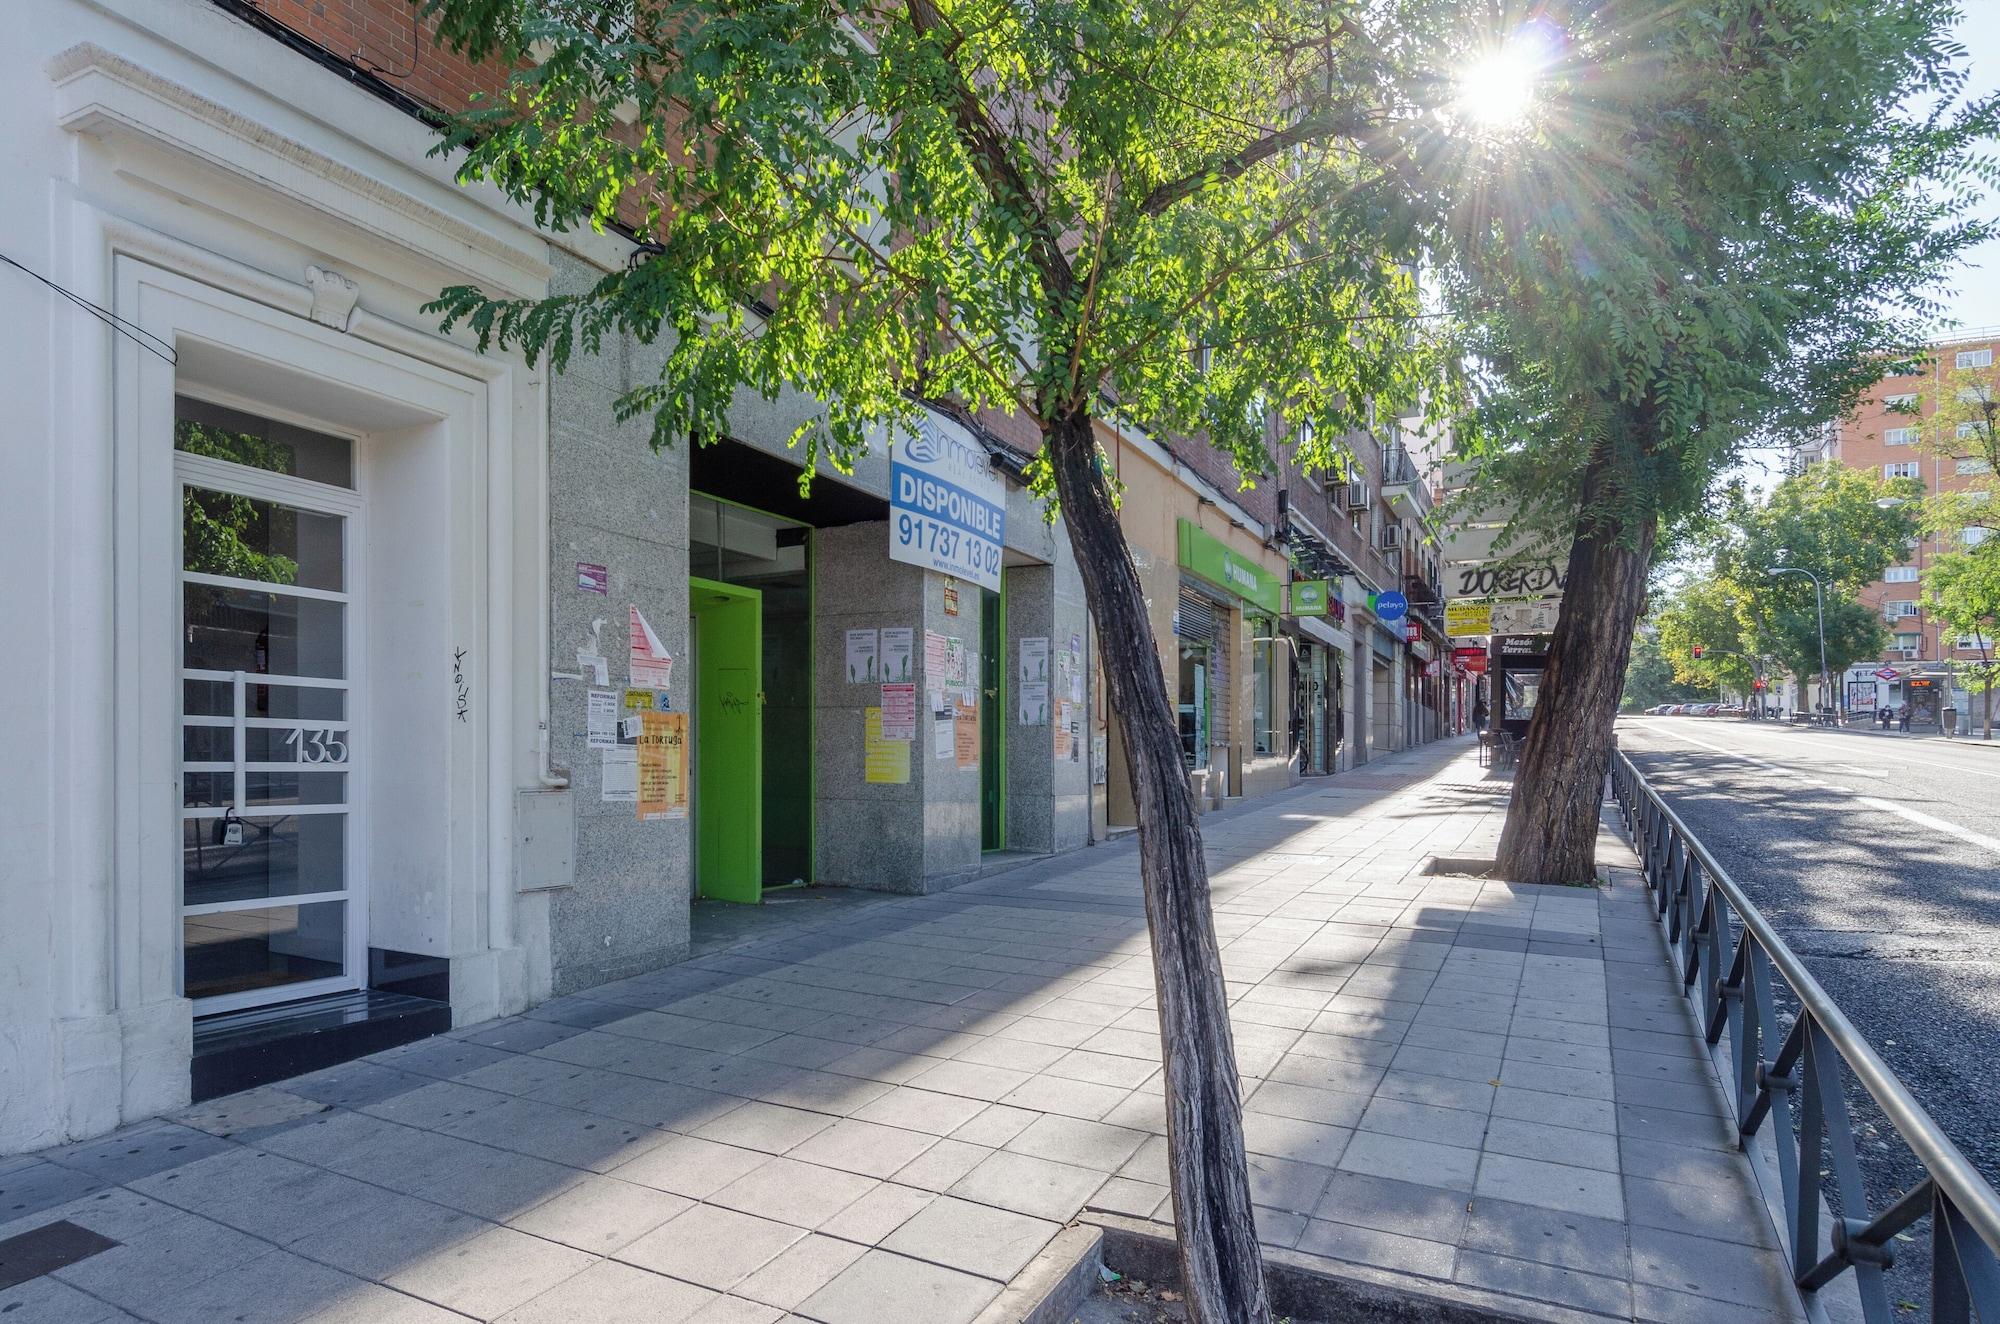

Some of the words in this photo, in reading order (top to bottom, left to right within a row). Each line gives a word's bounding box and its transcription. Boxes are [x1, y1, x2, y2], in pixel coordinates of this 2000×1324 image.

[899, 472, 1001, 540] DISPONIBLE
[898, 513, 923, 549] 91
[928, 524, 960, 560] 737
[965, 539, 981, 569] 13
[985, 546, 999, 576] 02
[1232, 563, 1257, 592] HUMANA
[1377, 601, 1404, 610] pelayo
[285, 728, 348, 764] 135
